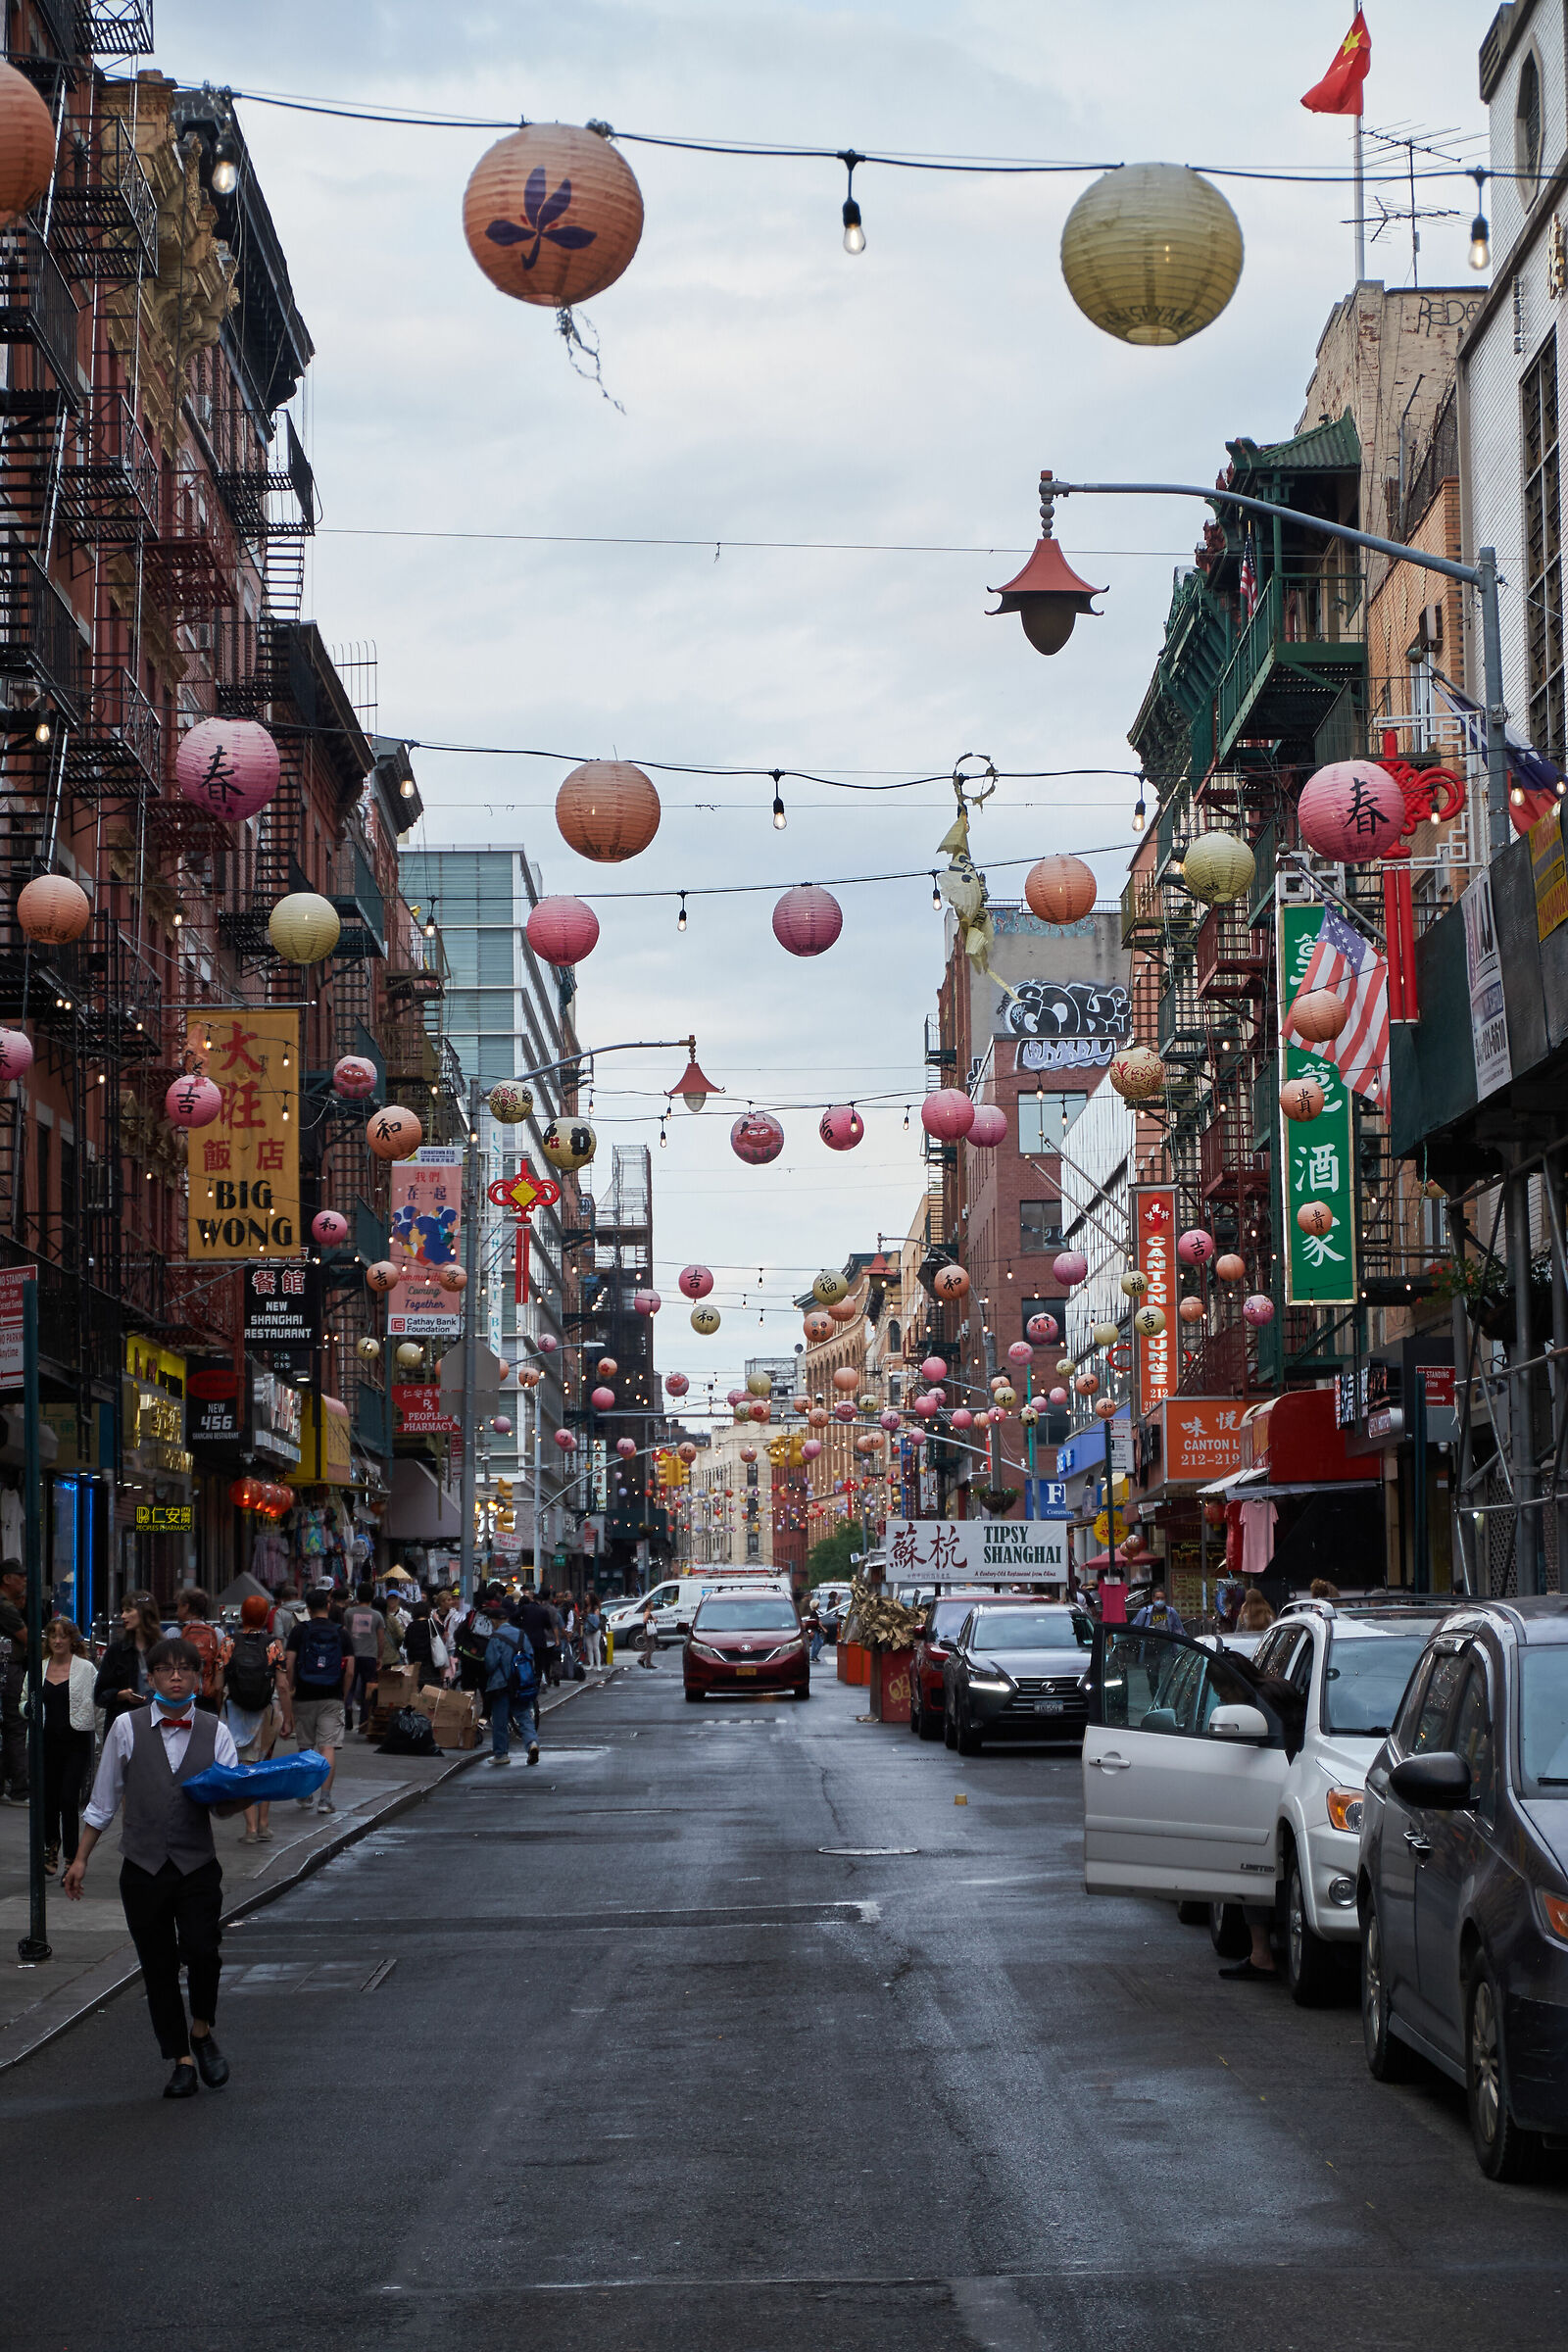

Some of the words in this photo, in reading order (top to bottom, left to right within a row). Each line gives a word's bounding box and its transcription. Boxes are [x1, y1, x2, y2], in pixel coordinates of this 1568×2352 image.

[202, 746, 244, 804] 春
[1344, 777, 1389, 835] 春
[220, 1021, 267, 1129] 大旺
[176, 1086, 201, 1114] 吉
[1295, 1089, 1314, 1113] 貴
[376, 1118, 401, 1141] 和
[203, 1138, 285, 1172] 飯店
[416, 1171, 440, 1183] 我們
[216, 1180, 273, 1209] BIG
[408, 1185, 446, 1200] 在一起
[319, 1218, 337, 1232] 和
[1310, 1210, 1325, 1229] 貴
[196, 1217, 293, 1248] WONG
[1190, 1238, 1205, 1256] 吉
[373, 1270, 387, 1287] 吉
[1147, 1237, 1167, 1303] CANTON
[252, 1269, 306, 1295] 餐館
[687, 1270, 703, 1289] 吉
[819, 1275, 837, 1294] 福
[944, 1274, 961, 1292] 和
[1131, 1276, 1145, 1292] 福
[408, 1286, 441, 1298] Coming
[266, 1301, 288, 1311] NEW
[405, 1298, 445, 1311] Together
[251, 1315, 303, 1326] SHANGHAI
[407, 1318, 434, 1327] Cathay
[697, 1309, 713, 1323] 和
[1142, 1311, 1155, 1329] 吉
[244, 1328, 312, 1339] RESTAURANT
[1426, 1370, 1450, 1379] STANDING
[1084, 1378, 1095, 1389] 和
[1000, 1393, 1012, 1403] 和
[1151, 1389, 1168, 1398] 212
[208, 1403, 225, 1413] NEW
[1102, 1402, 1113, 1412] 和
[201, 1415, 232, 1430] 456
[1184, 1440, 1229, 1450] CANTON
[984, 1526, 1029, 1544] TIPSY
[889, 1522, 968, 1570] 蘇杭
[984, 1545, 1061, 1564] SHANGHAI
